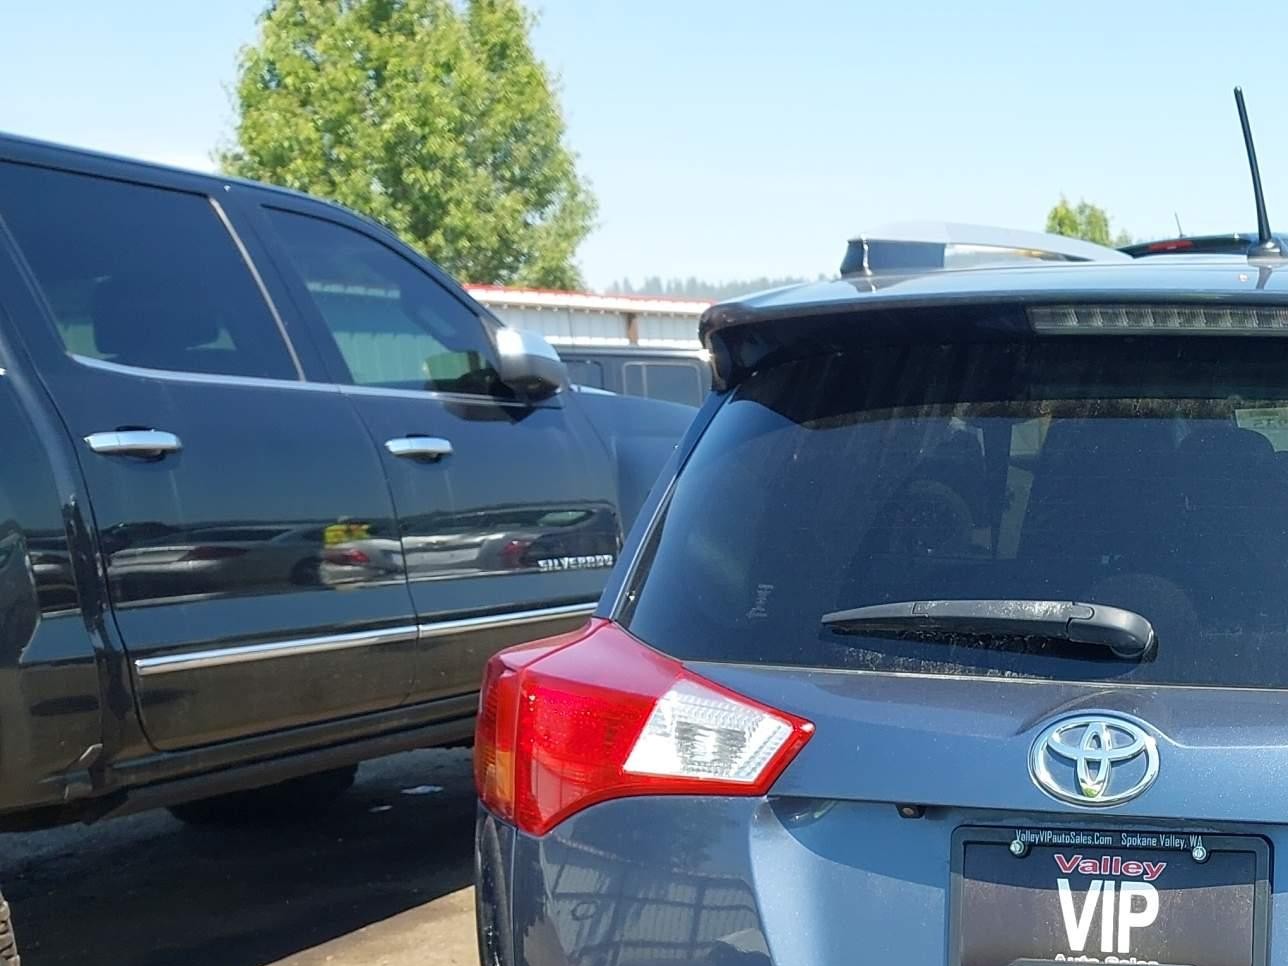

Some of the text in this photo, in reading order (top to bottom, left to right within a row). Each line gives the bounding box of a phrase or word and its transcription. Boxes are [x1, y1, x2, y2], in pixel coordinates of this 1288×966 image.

[1016, 829, 1112, 846] ValleyVIPautoSales.Com
[1121, 832, 1157, 848] Spokane
[1159, 834, 1187, 850] Valley,
[1054, 853, 1167, 880] Valley
[1056, 878, 1160, 954] VIP
